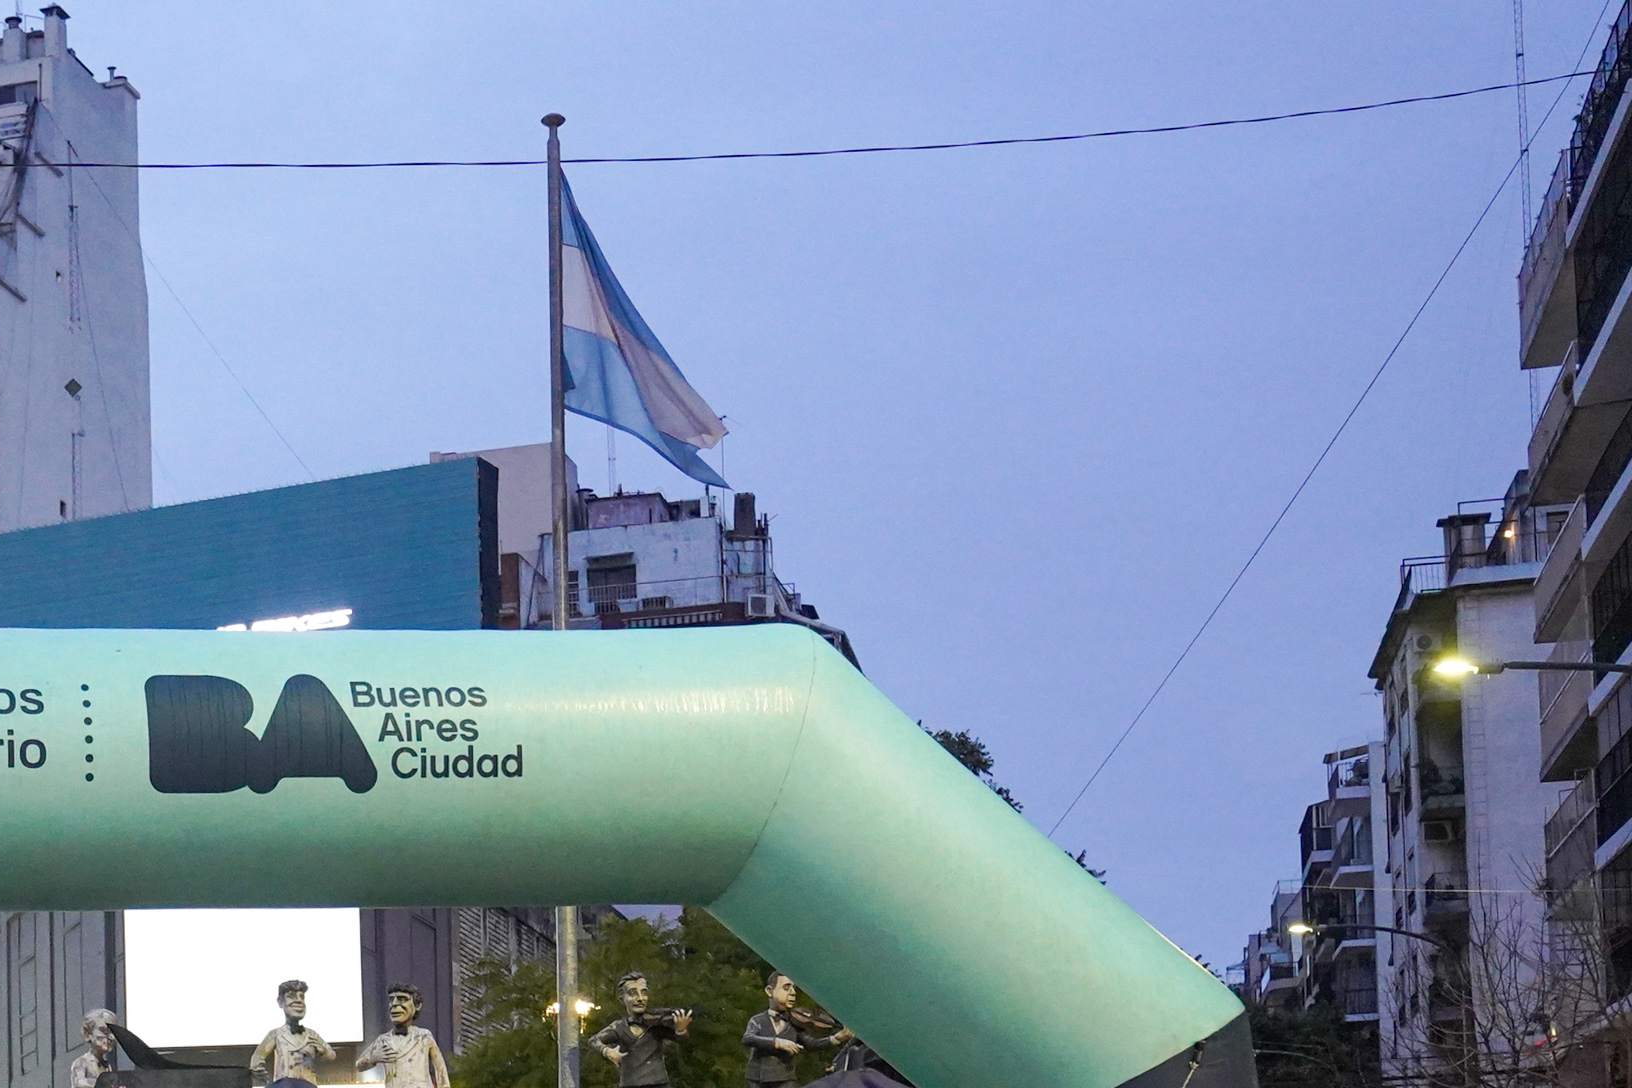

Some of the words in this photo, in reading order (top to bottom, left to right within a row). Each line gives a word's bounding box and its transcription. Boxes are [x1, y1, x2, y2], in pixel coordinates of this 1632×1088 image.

[349, 680, 488, 709] Buenos
[144, 673, 378, 794] BA
[378, 711, 480, 743] Aires
[390, 744, 524, 779] Ciudad
